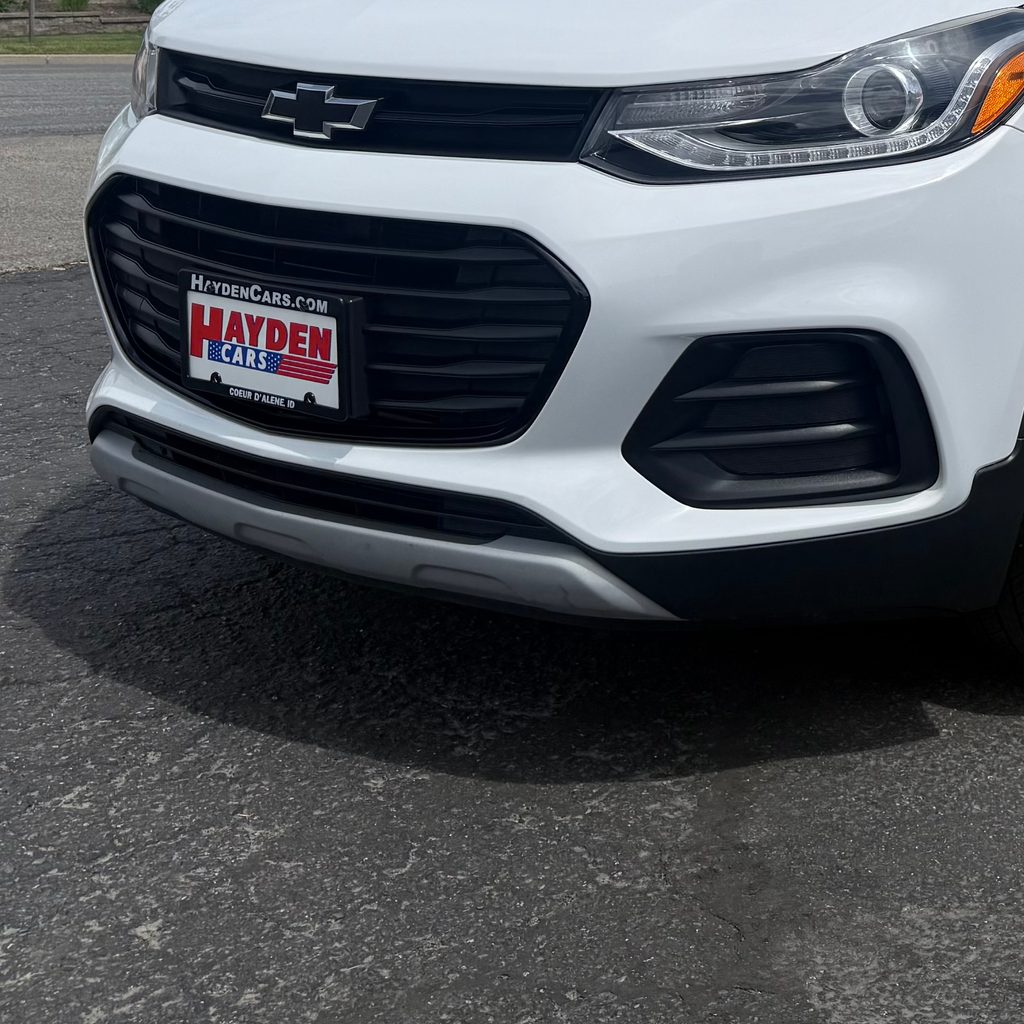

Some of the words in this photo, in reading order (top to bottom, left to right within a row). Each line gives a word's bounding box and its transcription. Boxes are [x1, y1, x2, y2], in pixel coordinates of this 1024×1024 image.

[190, 302, 332, 362] HAYDEN
[220, 343, 268, 370] CARS
[229, 387, 253, 400] COEUR
[287, 399, 295, 409] ID
